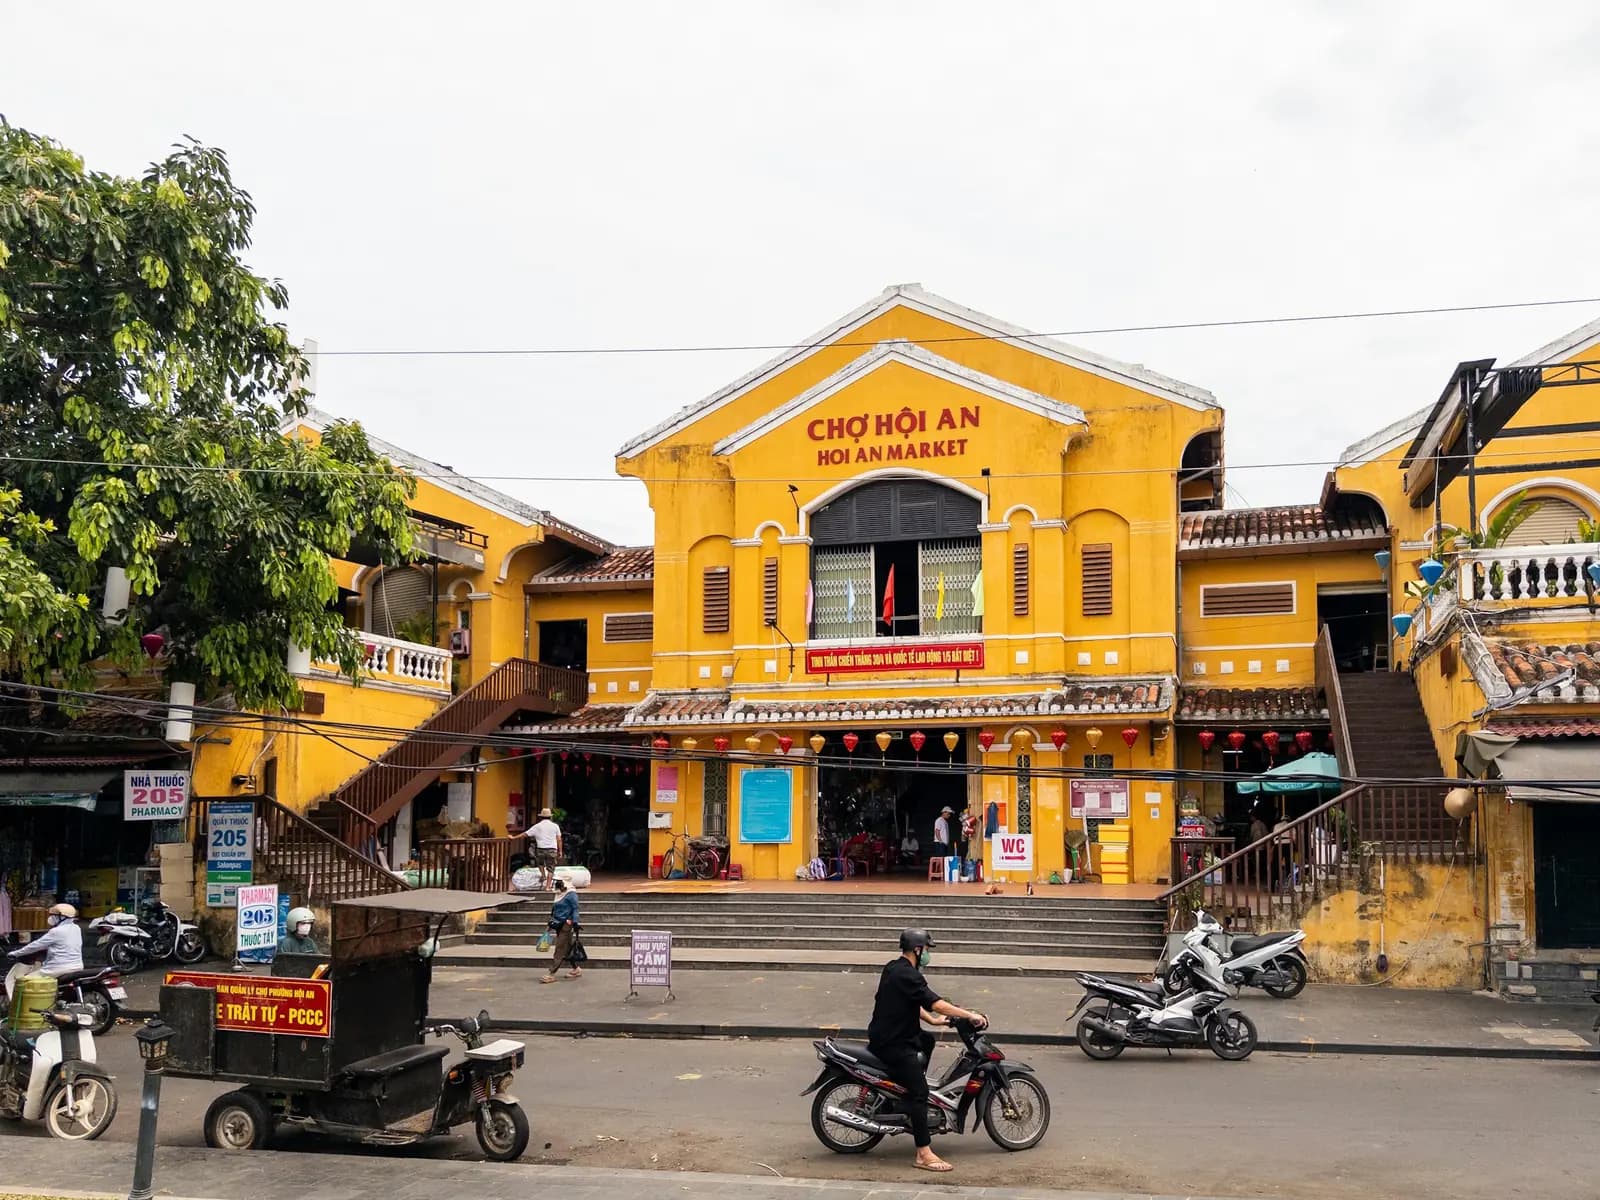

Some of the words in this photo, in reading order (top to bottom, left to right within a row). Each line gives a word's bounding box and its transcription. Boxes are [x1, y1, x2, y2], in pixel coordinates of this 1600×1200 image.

[807, 413, 869, 443] CHỢ
[875, 406, 926, 439] HỘI
[936, 406, 980, 430] AN
[817, 448, 850, 466] HOI
[855, 446, 882, 463] AN
[886, 439, 968, 461] MARKET
[838, 651, 854, 666] CHIẾN
[855, 650, 872, 666] THẮNG
[893, 649, 907, 665] QUỐC
[908, 649, 915, 663] TẾ
[915, 651, 925, 663] LAO
[926, 649, 941, 665] ĐỘNG
[943, 651, 951, 663] 1/5
[154, 773, 184, 787] THUỐC
[133, 788, 184, 804] 205
[131, 806, 183, 817] PHARMACY
[212, 829, 247, 846] 205
[1001, 838, 1025, 853] WC
[241, 888, 275, 905] PHARMACY
[243, 909, 273, 926] 205
[635, 942, 650, 950] KHU
[652, 942, 666, 952] VỰC
[634, 950, 667, 965] CẤM
[230, 984, 247, 995] QUẢN
[247, 985, 255, 995] LÝ
[269, 987, 293, 998] PHƯỜNG
[294, 989, 305, 999] HỘI
[305, 990, 315, 999] AN
[216, 1003, 223, 1019] E
[226, 1002, 257, 1024] TRẬT
[260, 1005, 278, 1026] TỰ
[288, 1008, 323, 1026] PCCC
